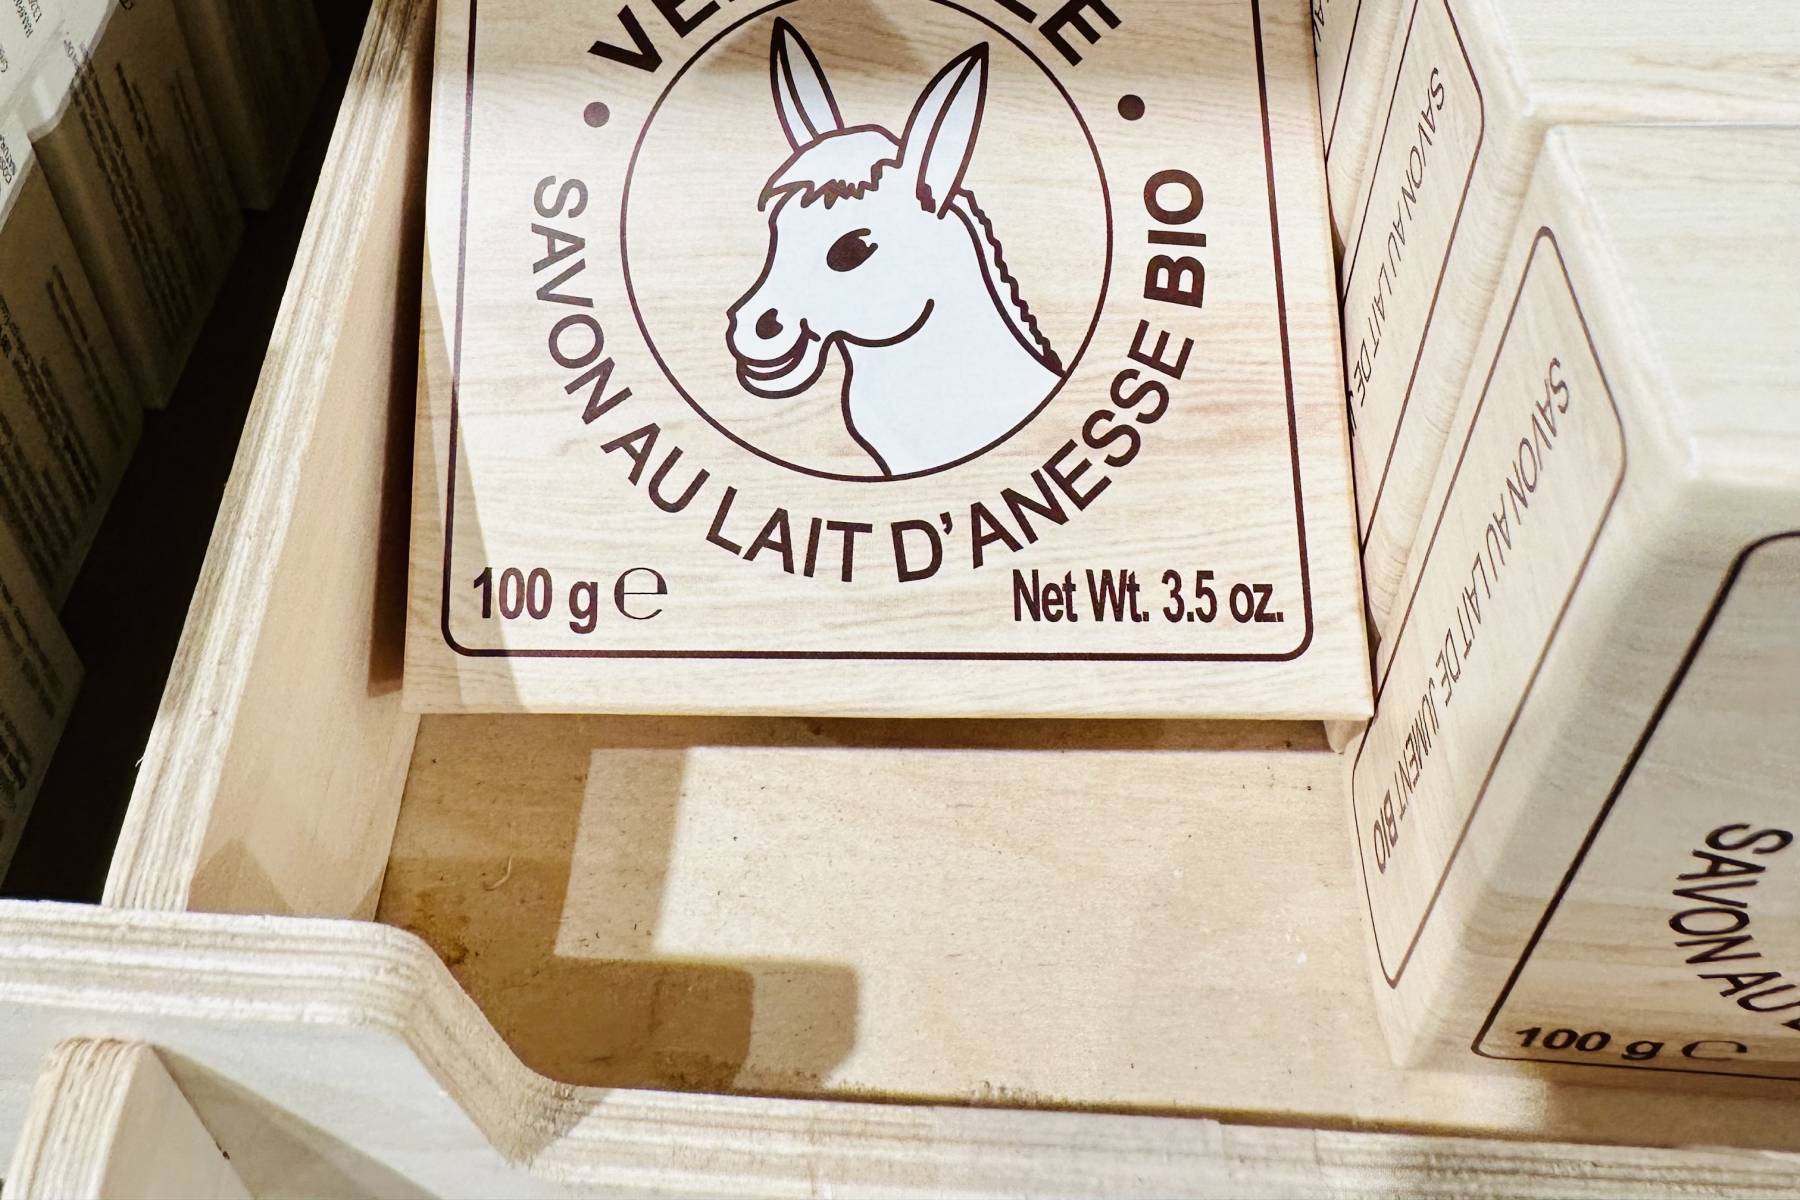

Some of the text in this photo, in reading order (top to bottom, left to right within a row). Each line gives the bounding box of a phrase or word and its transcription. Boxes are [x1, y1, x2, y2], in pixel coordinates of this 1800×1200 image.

[1354, 68, 1445, 407] SAVON AU LAIT DE
[531, 174, 632, 427] SAVON
[600, 423, 710, 513] AU
[706, 486, 873, 582] LAIT
[1144, 170, 1206, 308] BIO
[473, 567, 552, 619] 100
[569, 581, 598, 634] g
[1013, 569, 1284, 623] Net Wt. 3.5 oz.
[1374, 357, 1571, 875] SAVON AU LAIT DE JUMENT BIO
[1669, 824, 1800, 1012] SAVON AU
[1516, 1028, 1611, 1052] 100
[1621, 1041, 1664, 1061] g
